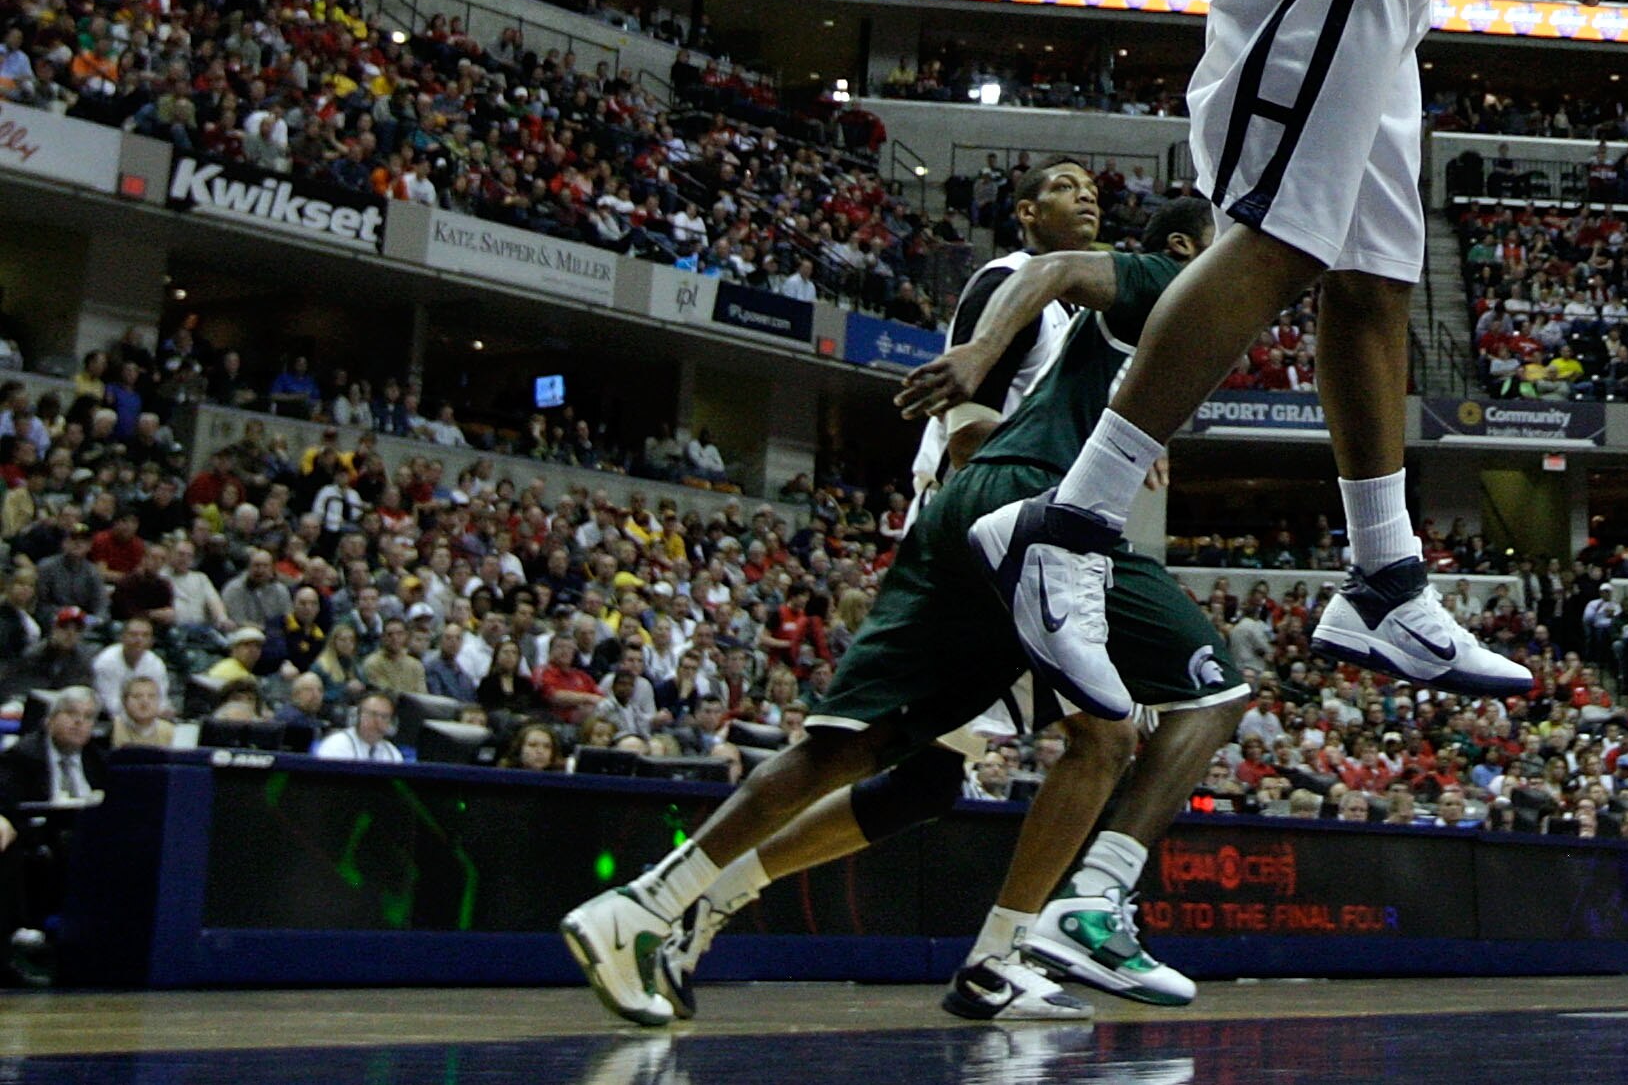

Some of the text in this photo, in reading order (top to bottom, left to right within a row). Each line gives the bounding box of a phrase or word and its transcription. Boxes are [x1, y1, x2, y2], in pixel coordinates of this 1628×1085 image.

[170, 157, 385, 243] Kwikset
[480, 232, 536, 266] SAPPER
[537, 247, 552, 268] &
[556, 249, 612, 282] MILLER
[1197, 401, 1269, 421] SPORT
[1485, 406, 1572, 428] Community
[1181, 901, 1215, 931] TO
[1222, 902, 1268, 931] THE
[1273, 903, 1337, 931] FINAL
